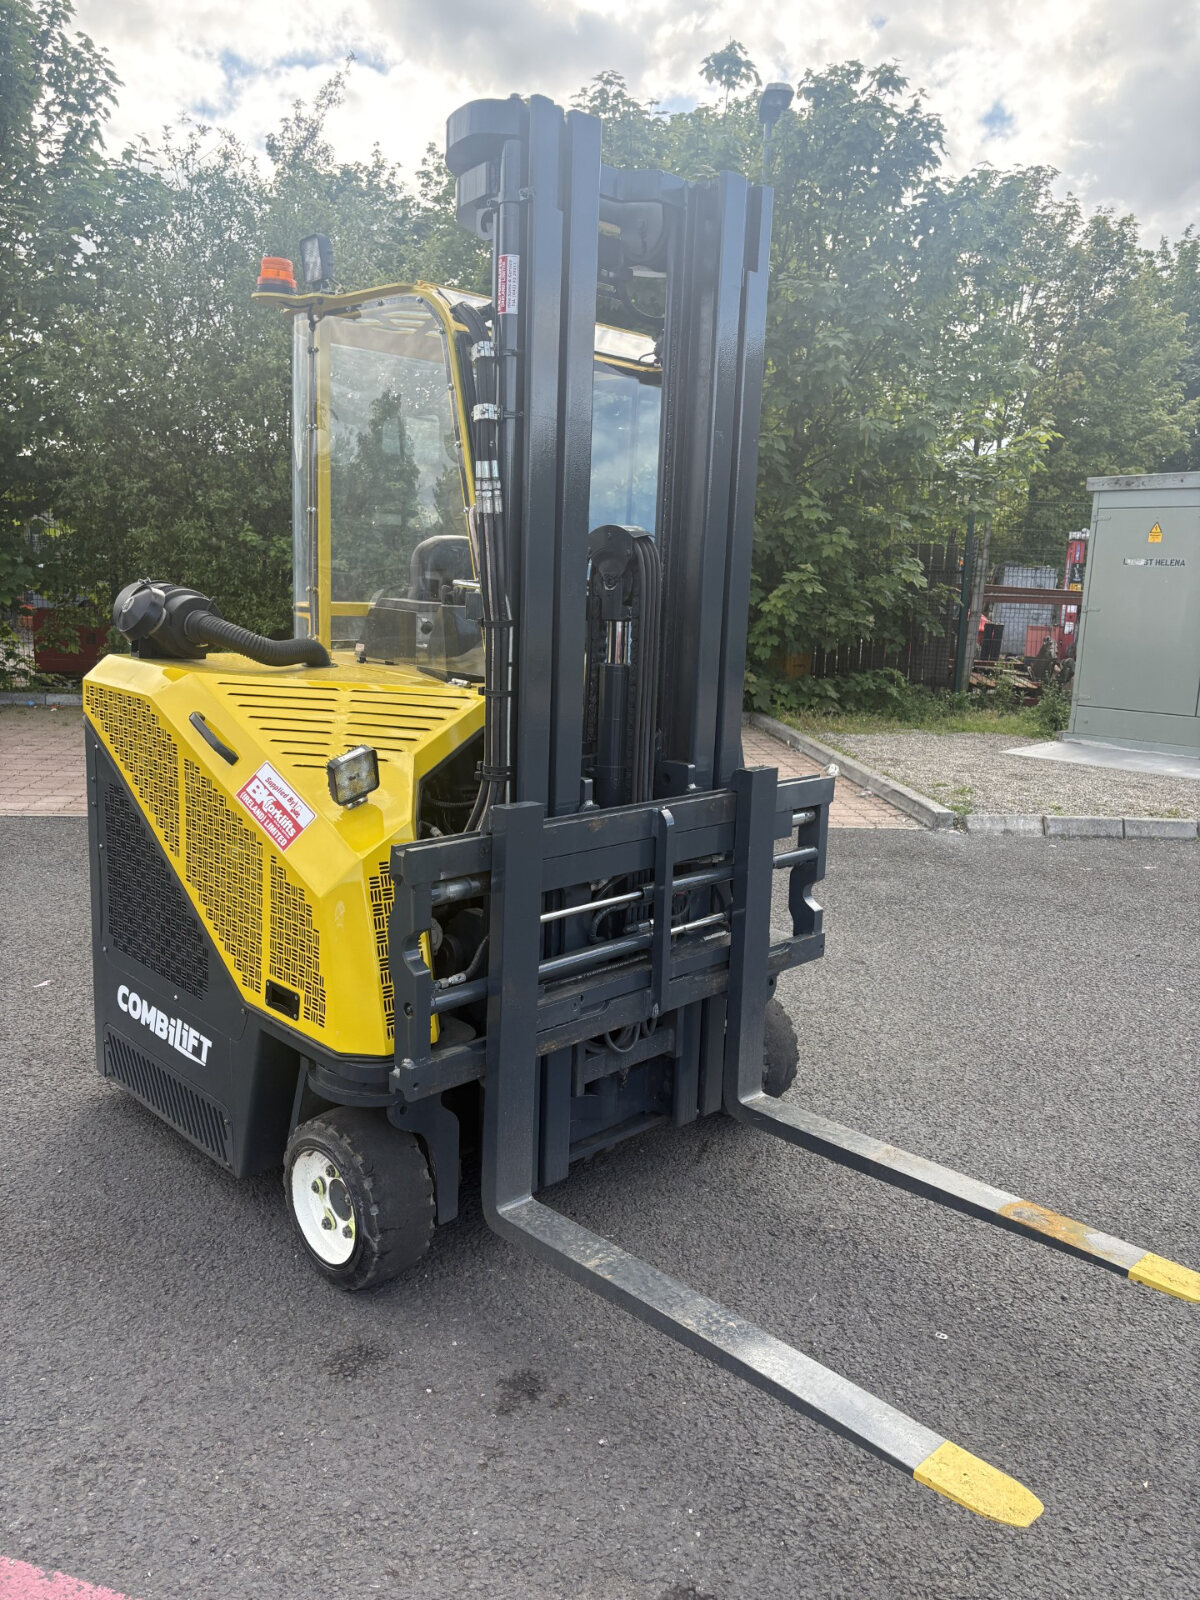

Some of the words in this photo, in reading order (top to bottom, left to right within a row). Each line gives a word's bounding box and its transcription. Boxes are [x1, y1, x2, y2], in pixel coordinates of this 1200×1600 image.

[1155, 558, 1186, 567] HELENA
[265, 777, 289, 798] Supplied
[240, 791, 267, 823] (IRELAND)
[263, 820, 288, 847] LIMITED
